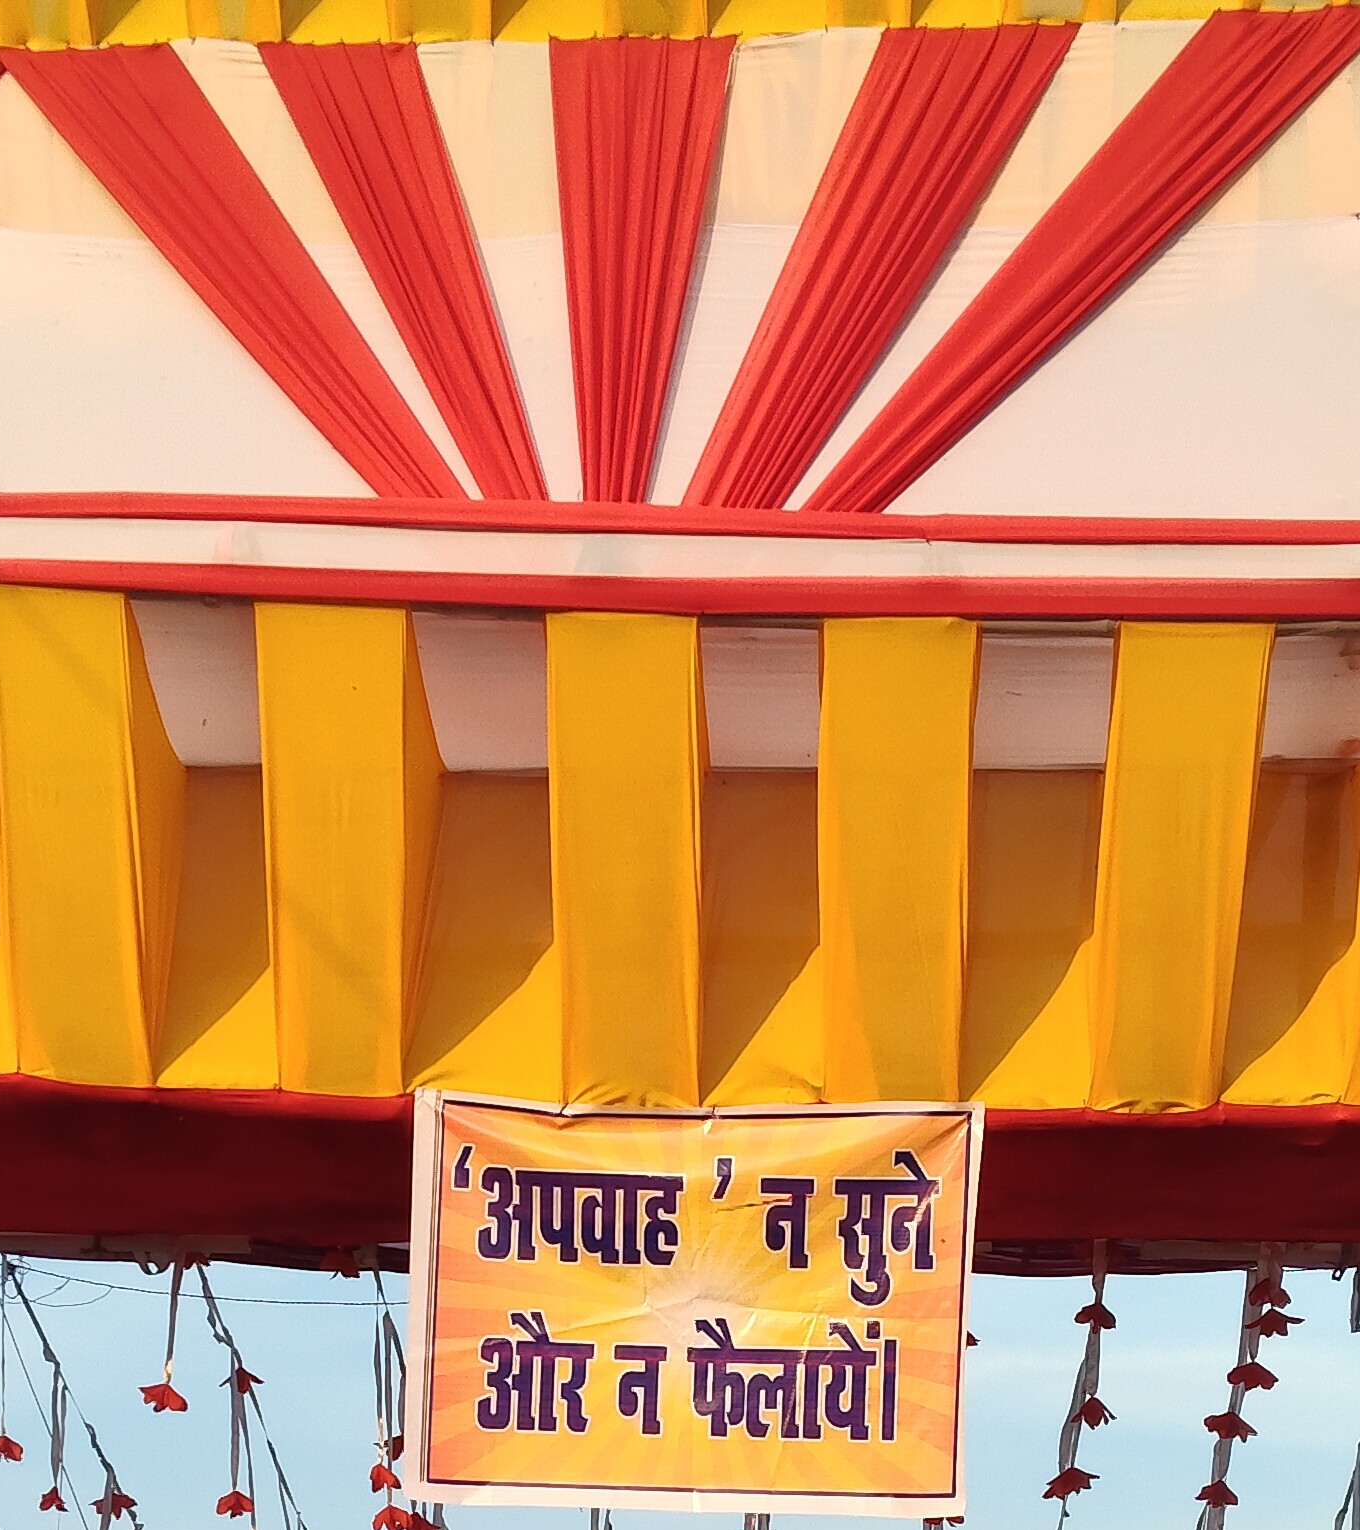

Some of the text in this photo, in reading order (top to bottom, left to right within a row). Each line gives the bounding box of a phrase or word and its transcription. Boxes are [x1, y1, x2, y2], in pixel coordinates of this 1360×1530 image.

[760, 1177, 814, 1269] न
[835, 1150, 939, 1306] सुने
[476, 1311, 595, 1433] और
[614, 1345, 667, 1436] न
